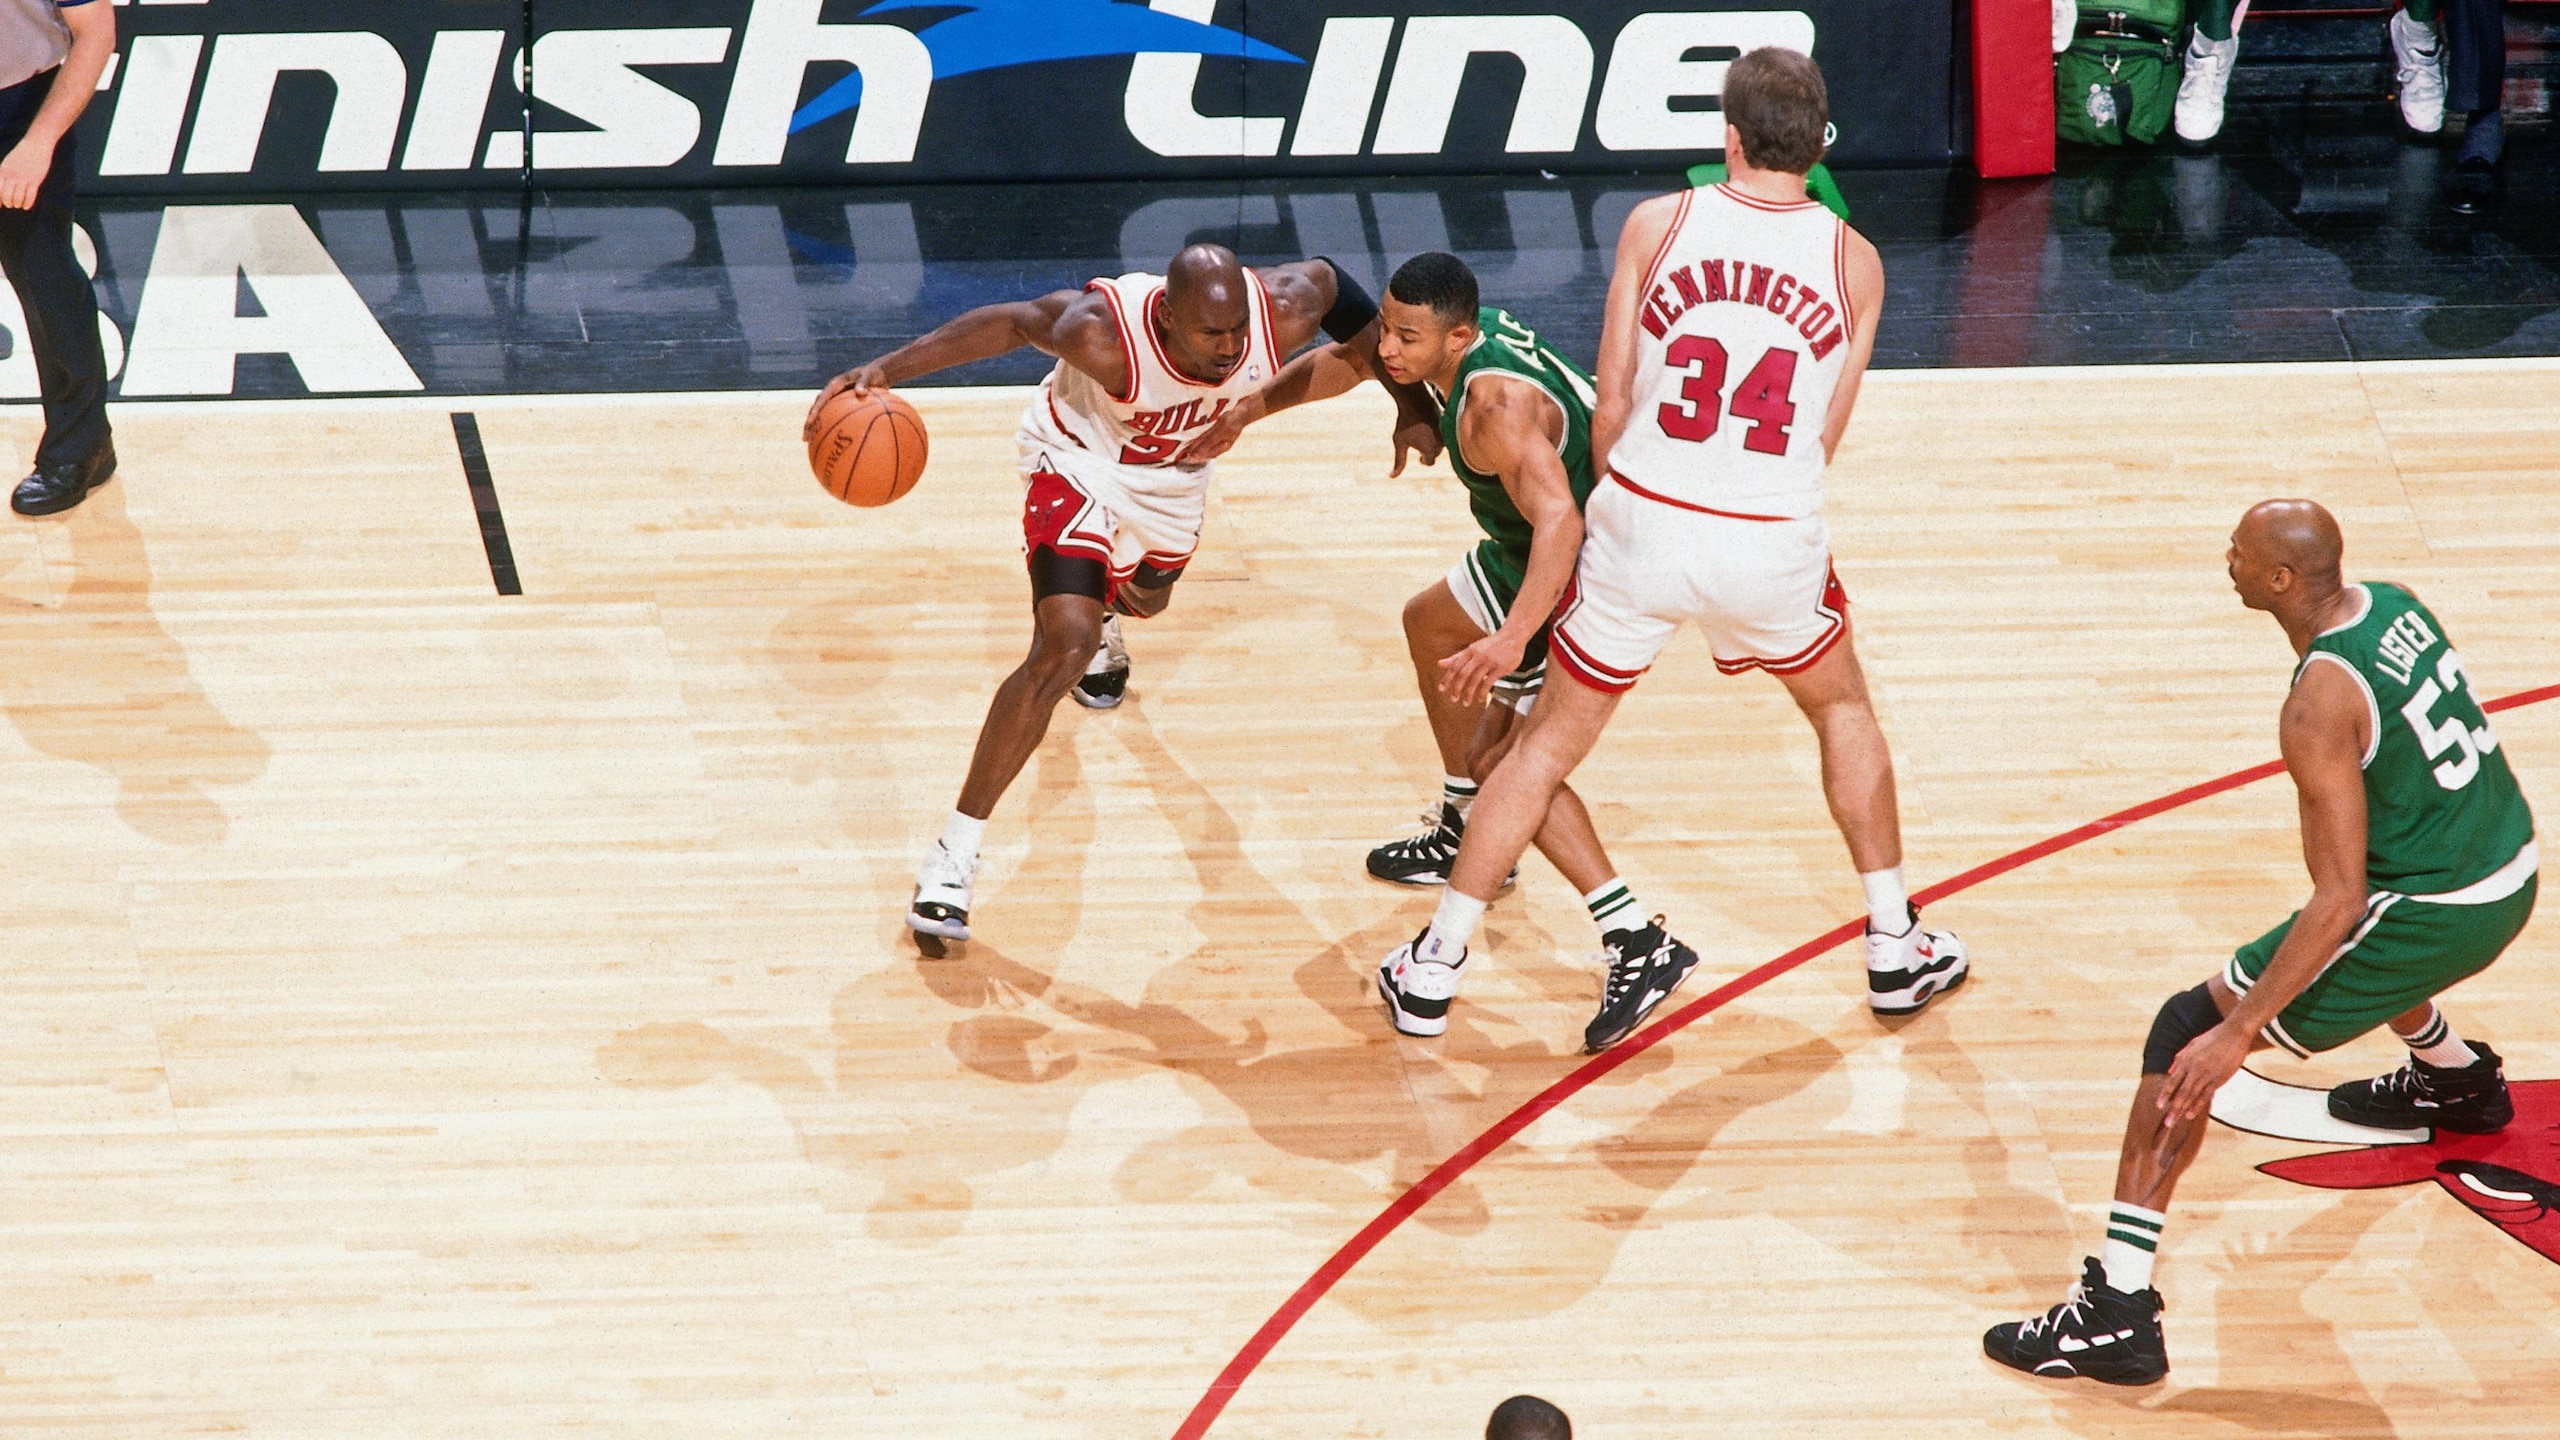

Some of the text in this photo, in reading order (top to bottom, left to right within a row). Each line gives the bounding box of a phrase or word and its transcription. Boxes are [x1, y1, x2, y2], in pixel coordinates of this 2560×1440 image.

[96, 0, 933, 175] inish
[1641, 259, 1843, 362] WENNINGTON
[1122, 396, 1250, 435] BULL
[1657, 334, 1798, 457] 34
[1119, 434, 1190, 468] 2
[2375, 610, 2438, 686] LISTER
[2401, 648, 2499, 791] 53
